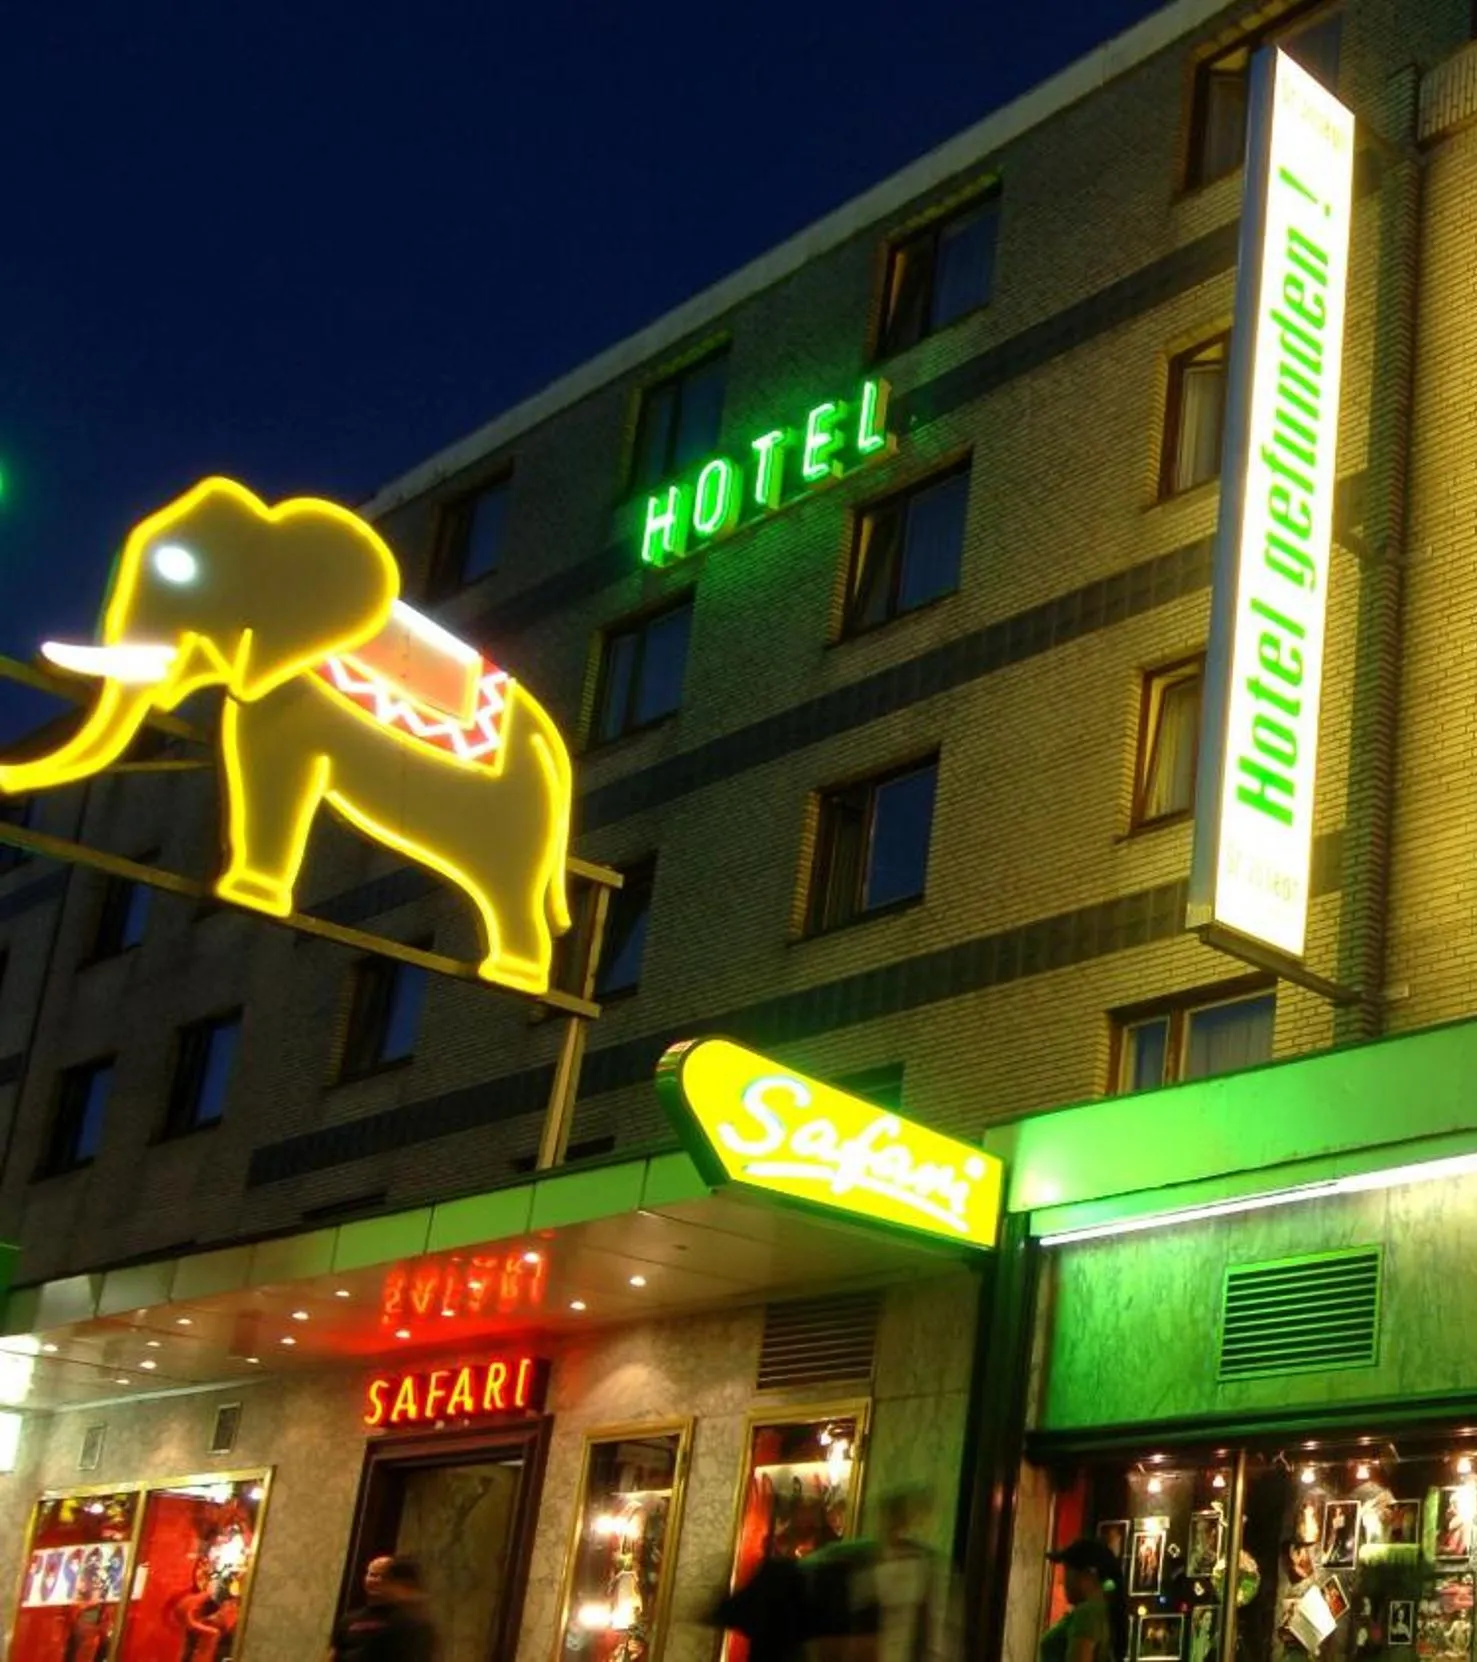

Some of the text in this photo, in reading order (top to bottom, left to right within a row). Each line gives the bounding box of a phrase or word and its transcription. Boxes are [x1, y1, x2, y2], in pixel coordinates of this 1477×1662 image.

[642, 379, 896, 567] HOTEL
[1260, 226, 1330, 594] gefunden
[1235, 597, 1306, 828] Hotel
[717, 1073, 985, 1232] Safari
[364, 1358, 532, 1424] SAFARI
